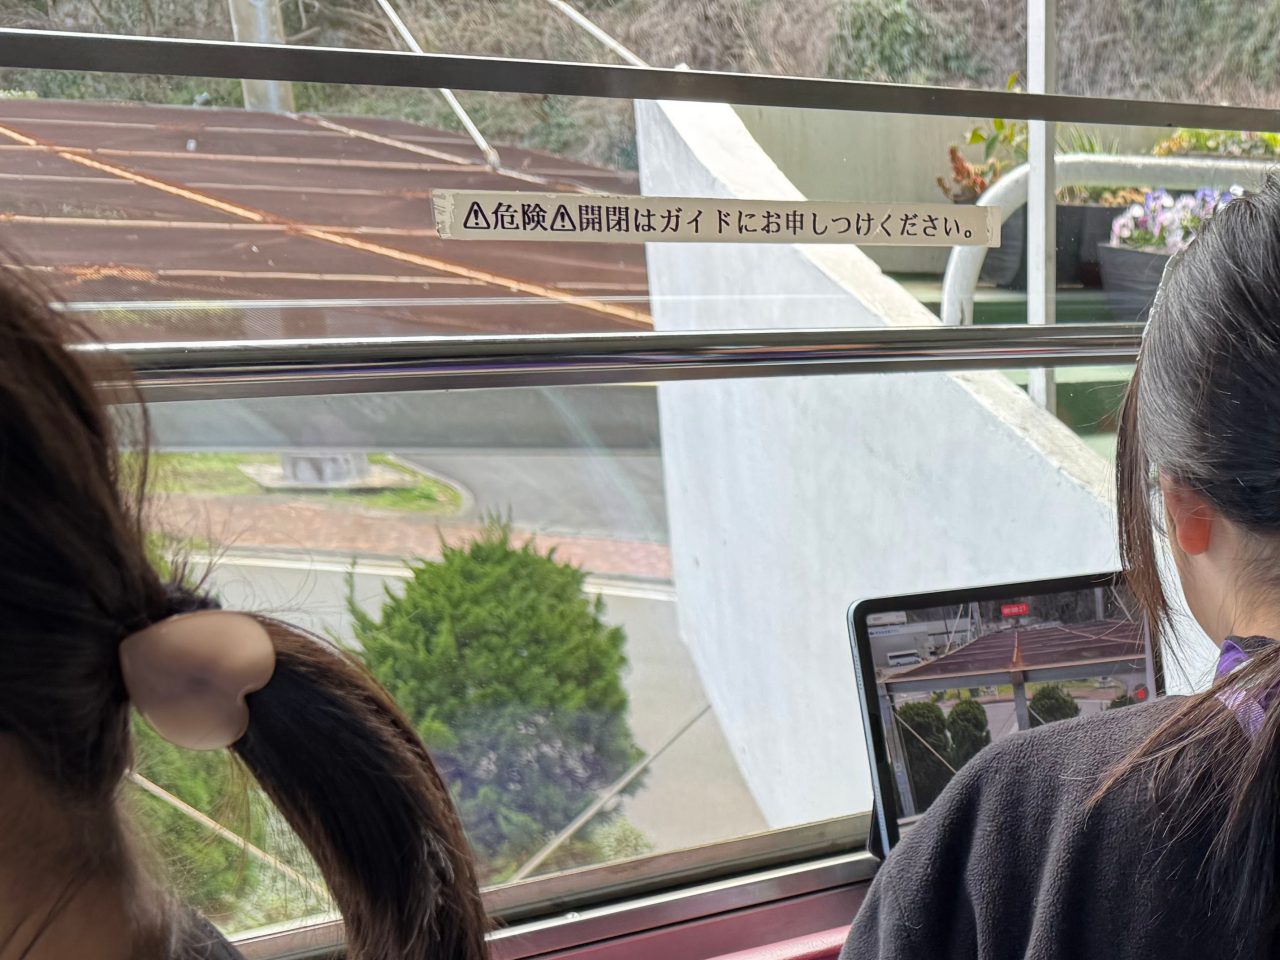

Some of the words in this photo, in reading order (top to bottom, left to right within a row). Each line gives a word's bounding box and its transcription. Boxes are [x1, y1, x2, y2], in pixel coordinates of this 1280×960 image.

[578, 205, 974, 240] 開閉はガイドにお申しつけください。
